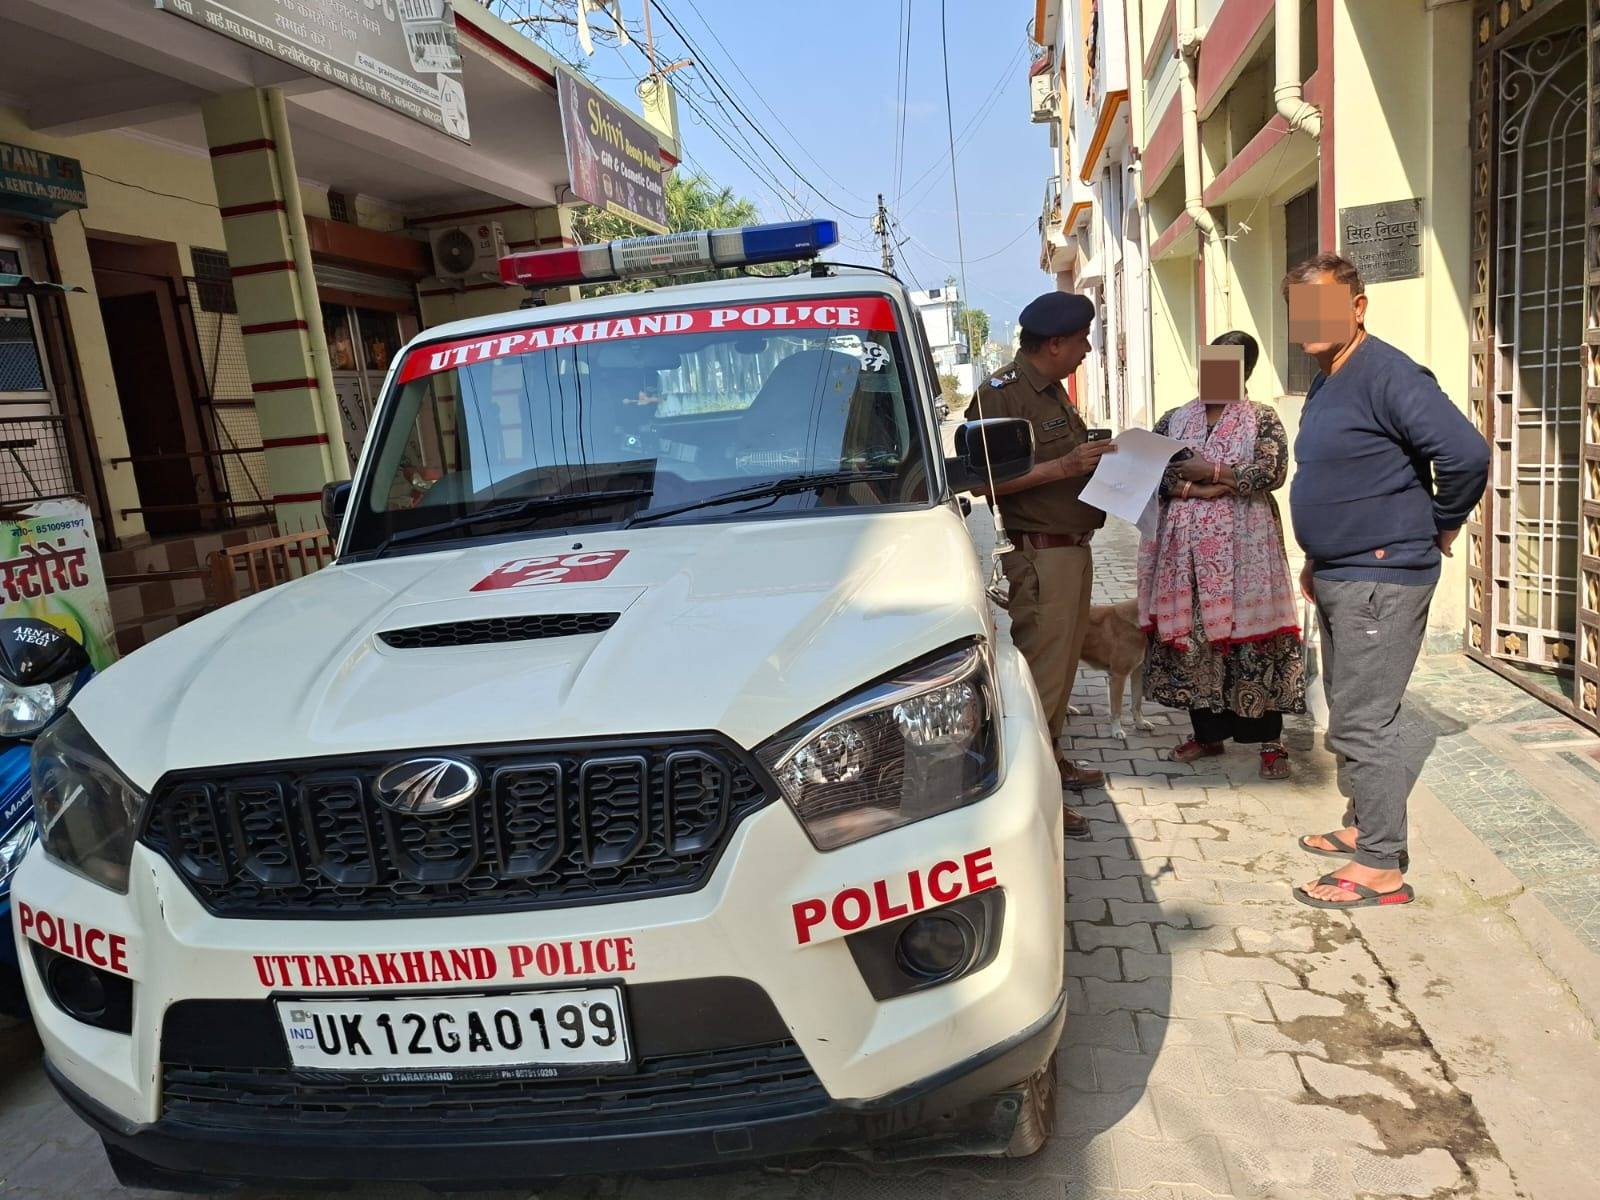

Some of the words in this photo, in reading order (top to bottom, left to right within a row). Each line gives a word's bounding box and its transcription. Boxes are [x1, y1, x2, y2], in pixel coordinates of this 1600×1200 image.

[587, 97, 625, 151] Shivi
[601, 149, 614, 170] Gift
[1345, 224, 1371, 241] सिंह
[1376, 221, 1417, 236] निवास
[36, 518, 85, 534] 8510098197
[499, 551, 616, 575] PC
[511, 567, 571, 587] 2
[12, 625, 60, 643] ARNAV
[15, 632, 50, 648] NEGI
[792, 847, 996, 944] POLICE
[18, 900, 130, 974] POLICE
[252, 946, 498, 988] UTTARAKHAND
[508, 936, 636, 979] POLICE
[289, 1028, 314, 1040] IND
[382, 1071, 453, 1083] UTTARAKHAND
